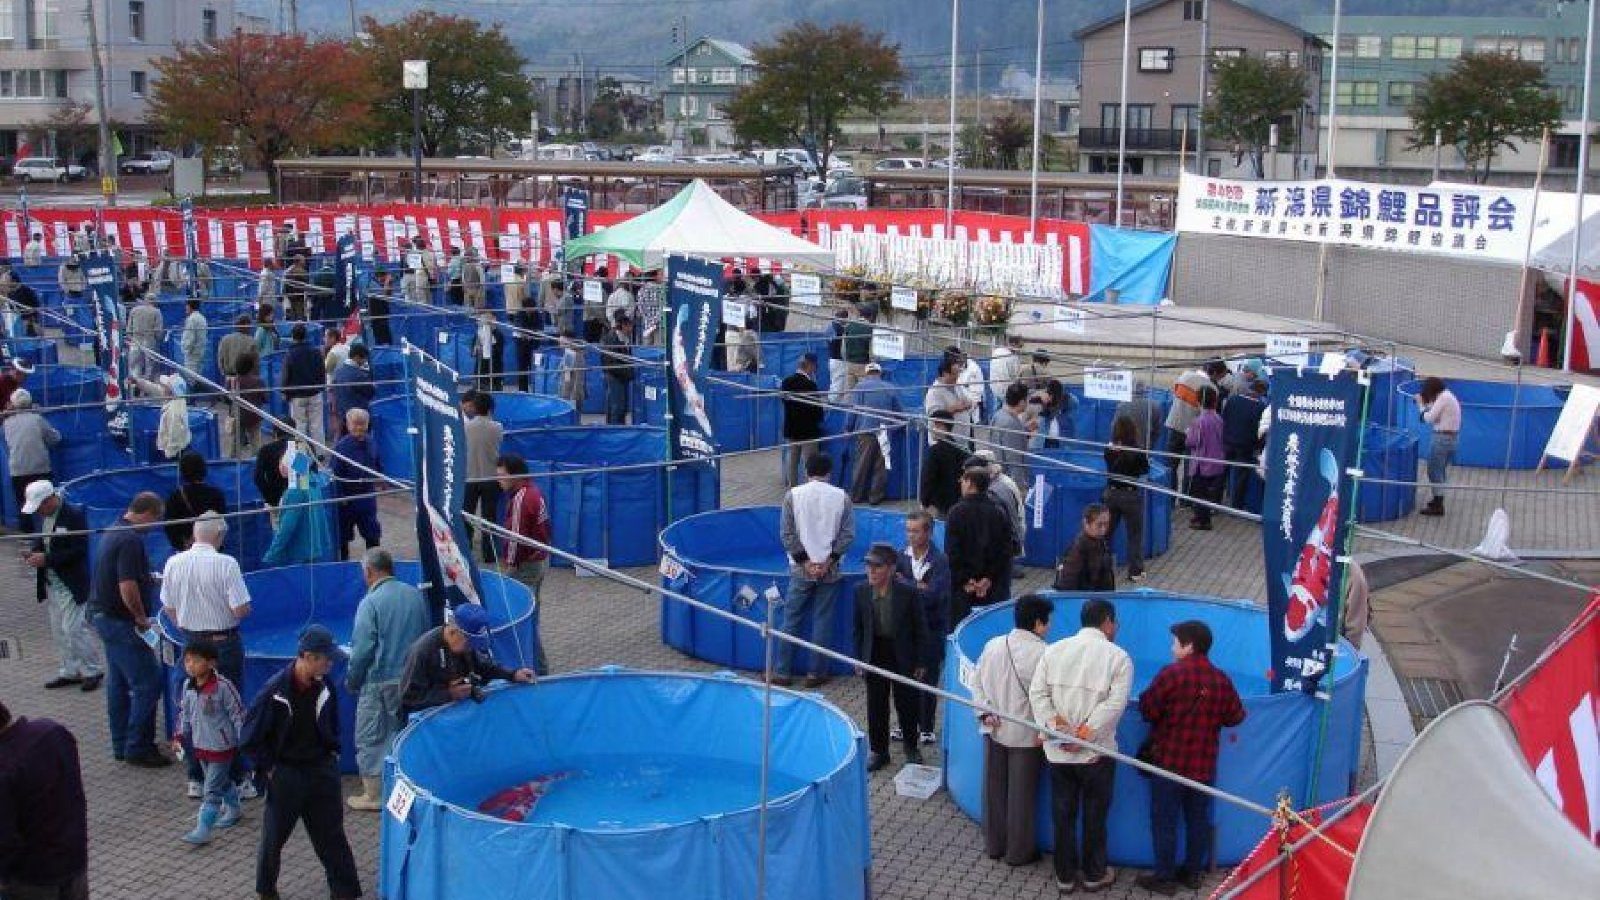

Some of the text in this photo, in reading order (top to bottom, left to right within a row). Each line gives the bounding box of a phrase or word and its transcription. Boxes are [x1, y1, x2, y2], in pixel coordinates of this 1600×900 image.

[1254, 185, 1516, 232] 新潟県錦鯉品評会
